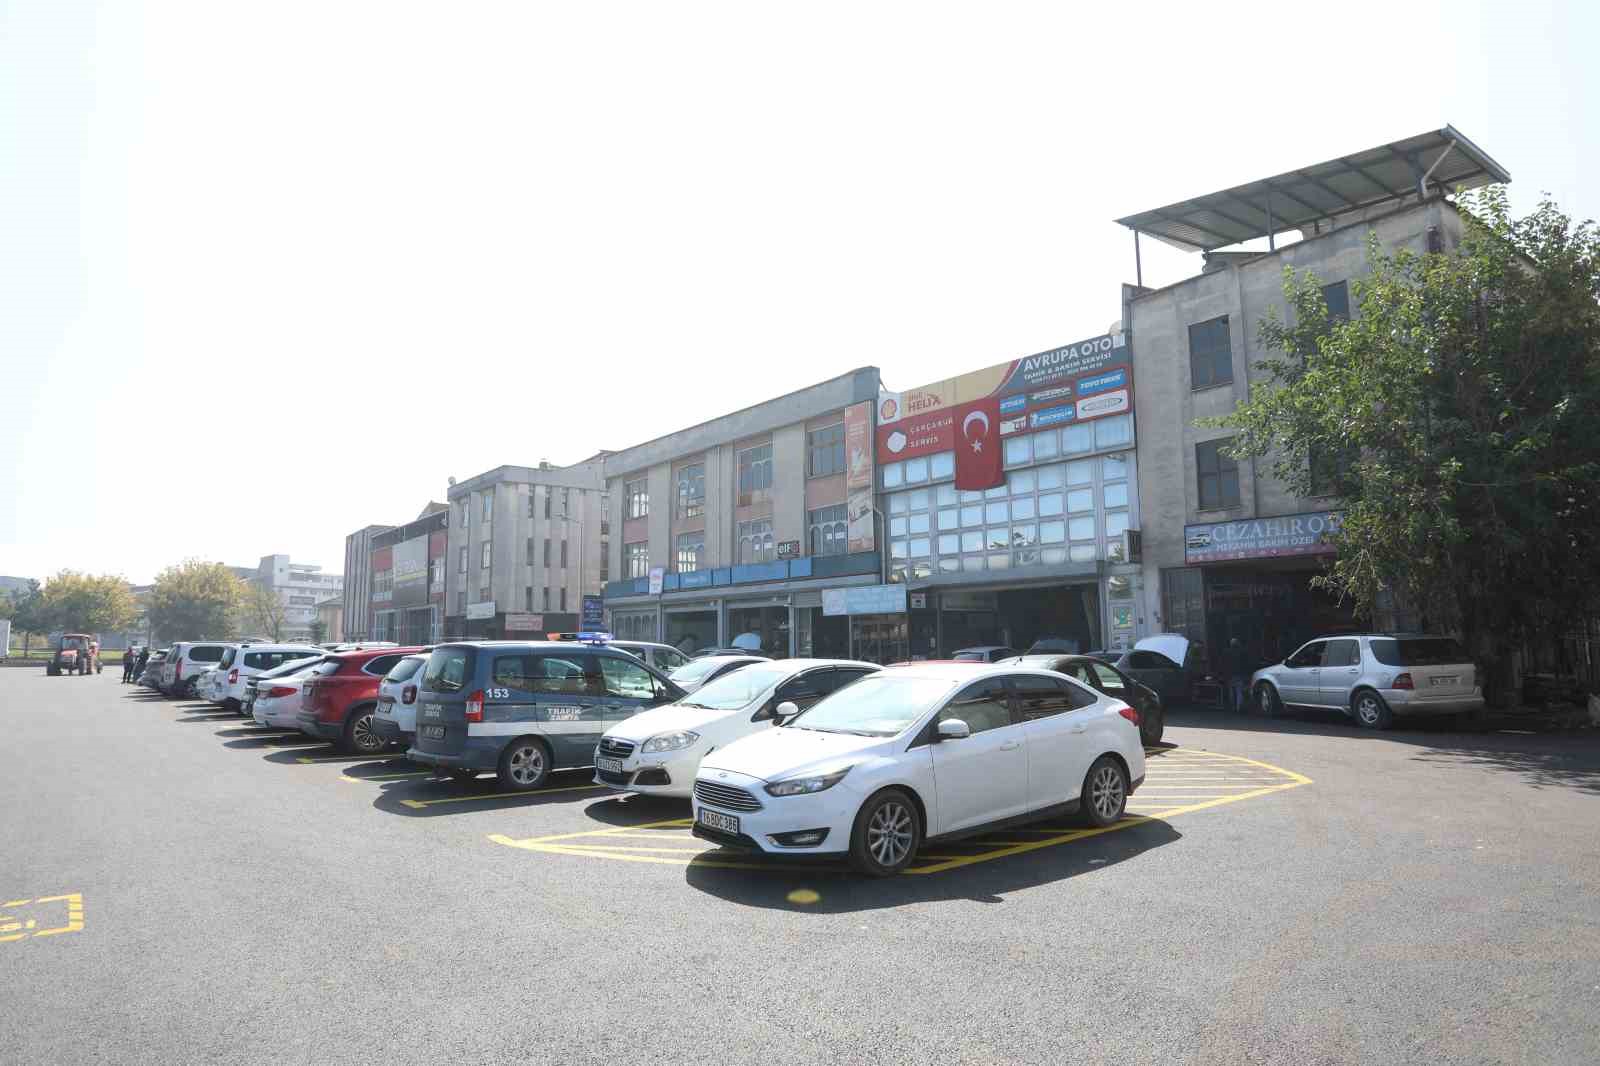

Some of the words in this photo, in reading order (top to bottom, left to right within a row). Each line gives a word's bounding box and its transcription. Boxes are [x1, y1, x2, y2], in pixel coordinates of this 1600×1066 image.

[1023, 347, 1079, 372] AVRUPA
[1081, 338, 1112, 356] OTO
[486, 688, 510, 699] 153
